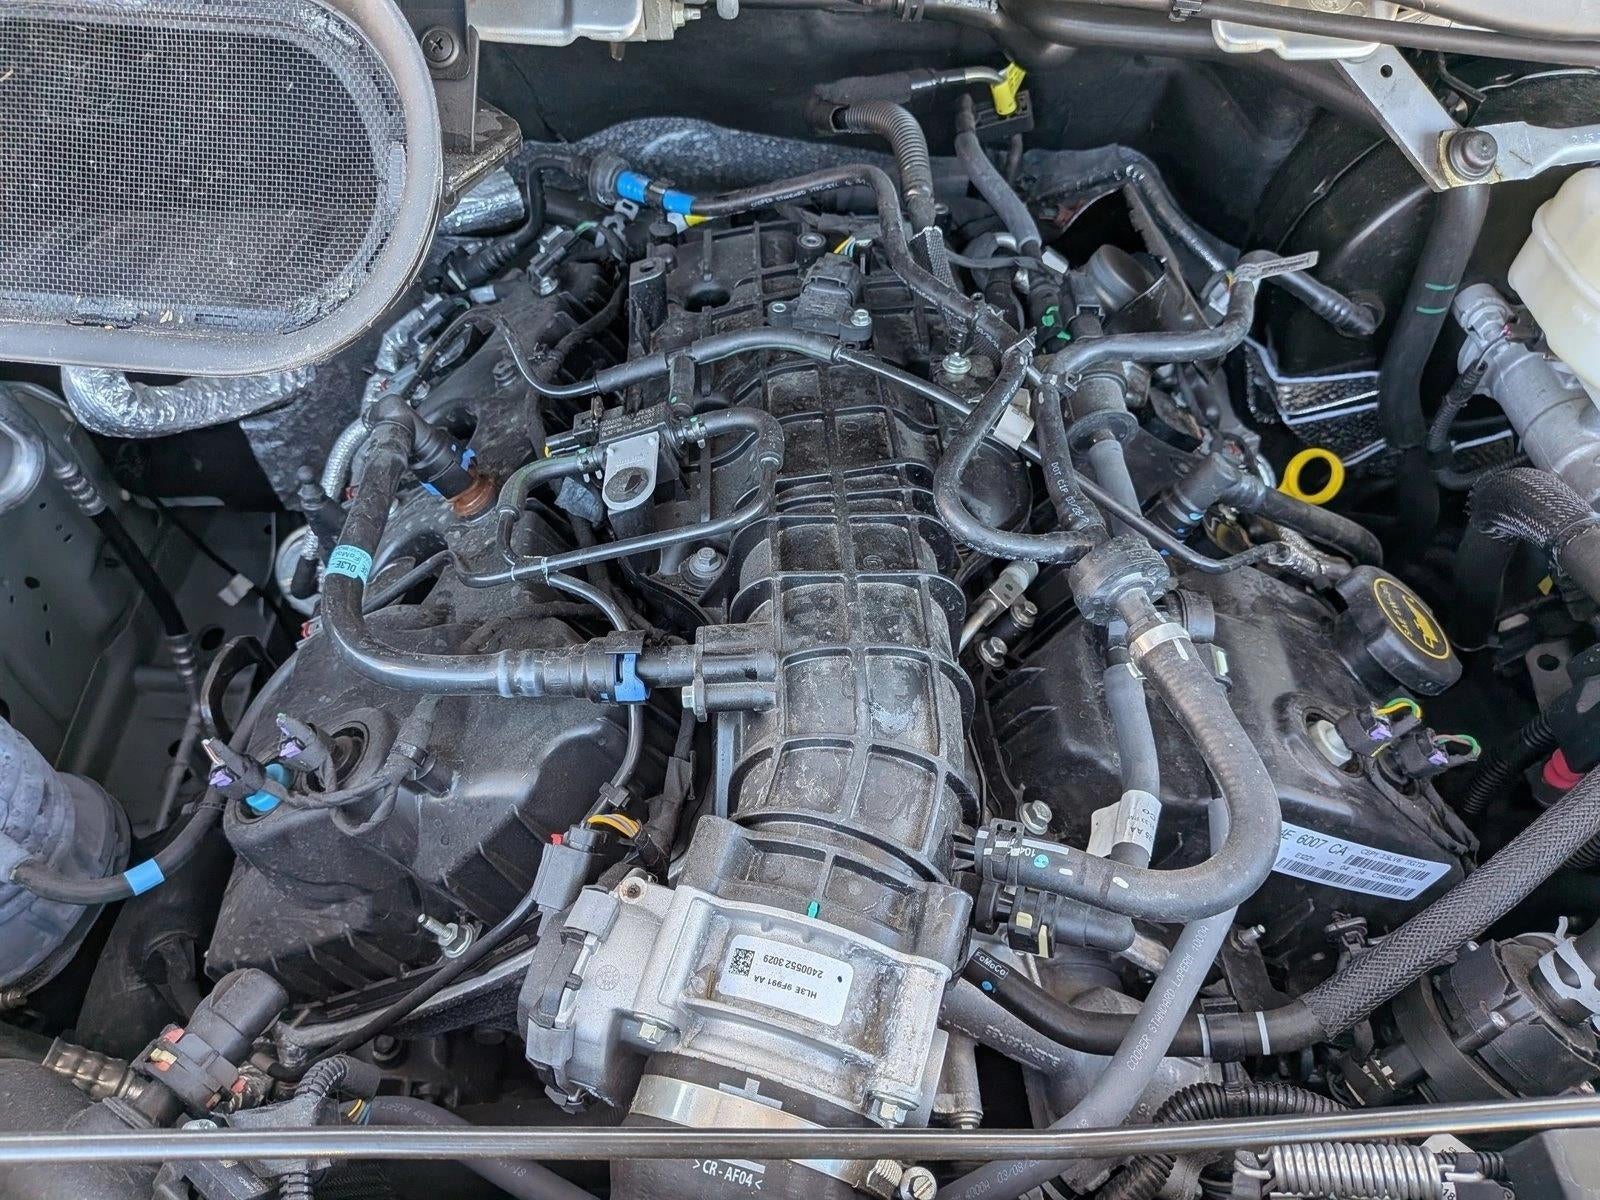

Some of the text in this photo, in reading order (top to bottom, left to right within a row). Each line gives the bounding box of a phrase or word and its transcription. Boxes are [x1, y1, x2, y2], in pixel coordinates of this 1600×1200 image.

[1051, 461, 1062, 476] DOT
[1296, 833, 1328, 849] 6007
[1327, 843, 1349, 857] CA
[974, 951, 1006, 976] FoMoCo
[754, 974, 818, 1000] HL3E 9F991 AA
[1126, 1034, 1152, 1071] COOPER
